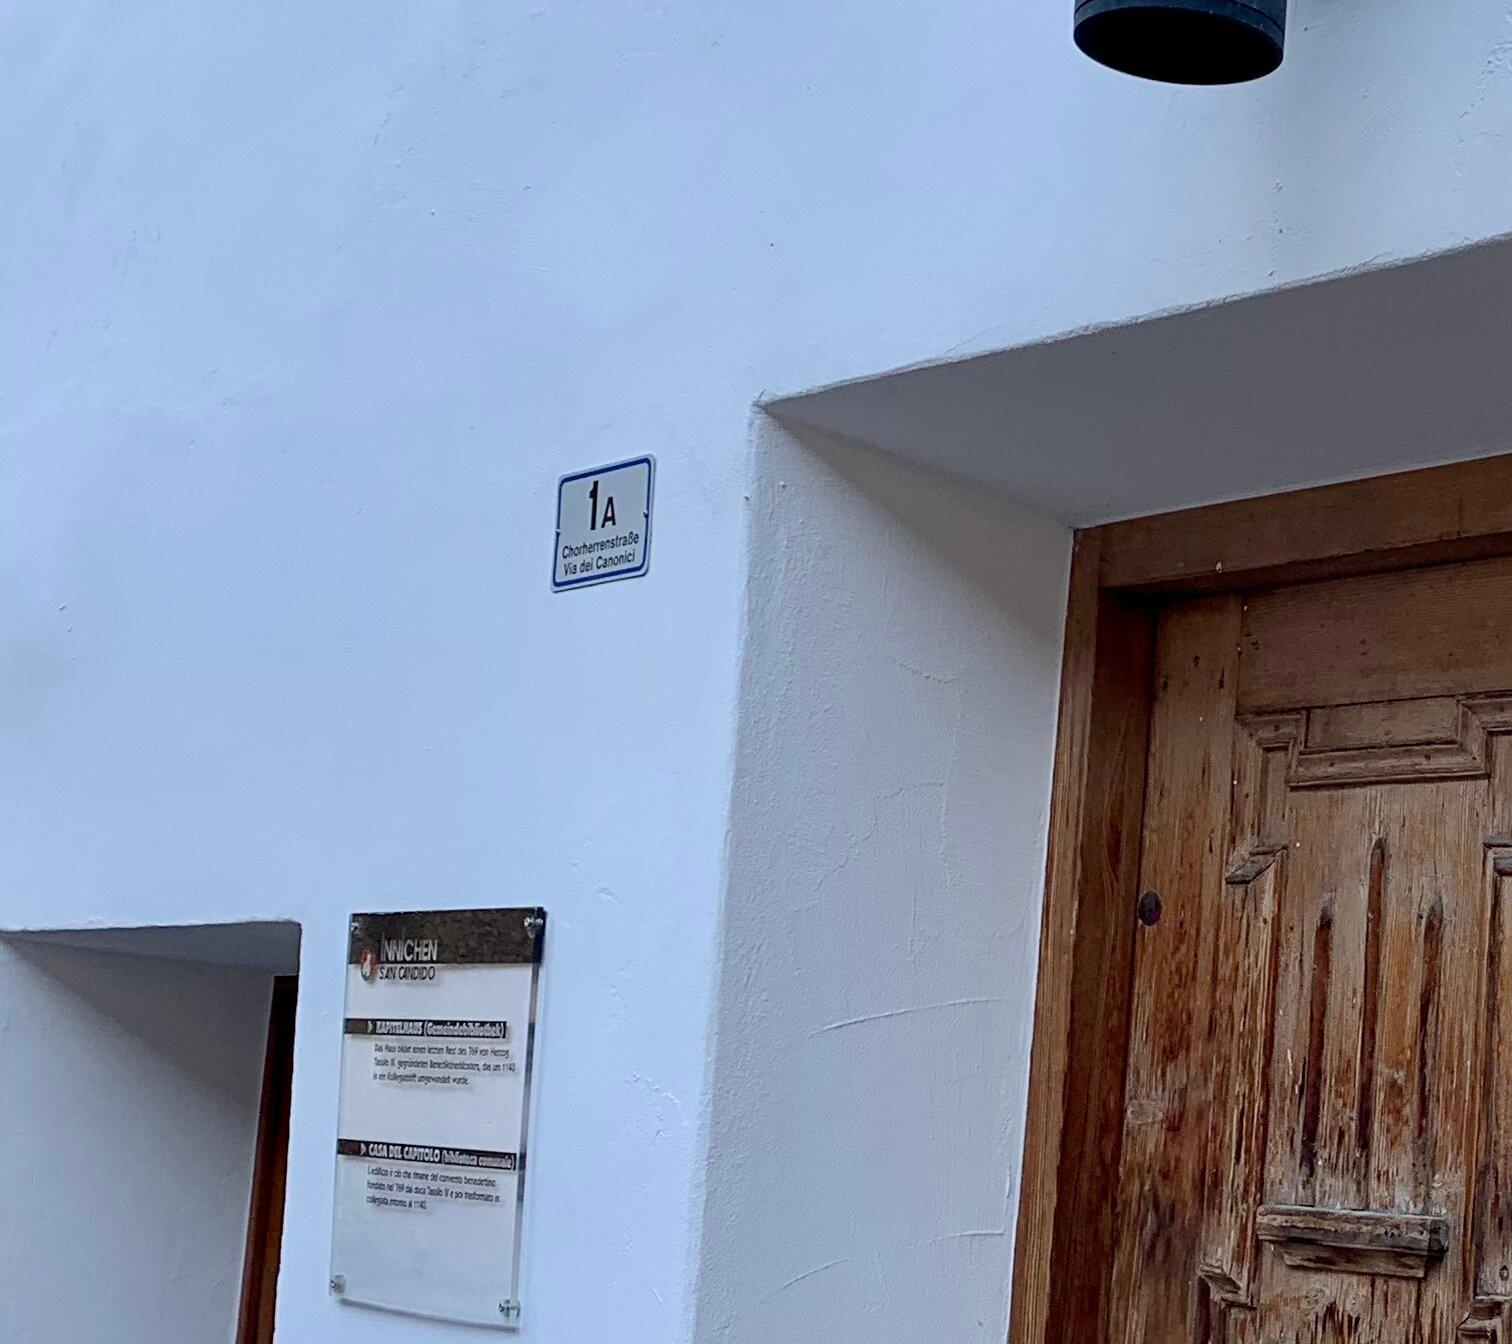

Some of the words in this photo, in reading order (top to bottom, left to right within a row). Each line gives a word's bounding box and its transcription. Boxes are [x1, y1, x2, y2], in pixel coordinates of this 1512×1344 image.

[562, 531, 640, 559] Chorherrenstraße
[564, 563, 577, 576] Via
[580, 559, 593, 572] dei
[596, 549, 635, 570] Canonici
[380, 934, 438, 961] INNICHEN
[379, 966, 396, 980] SAN
[399, 966, 436, 980] CANDIDO
[368, 1143, 387, 1157] CASA
[388, 1145, 402, 1158] DEL
[403, 1147, 440, 1163] CAPITOLO
